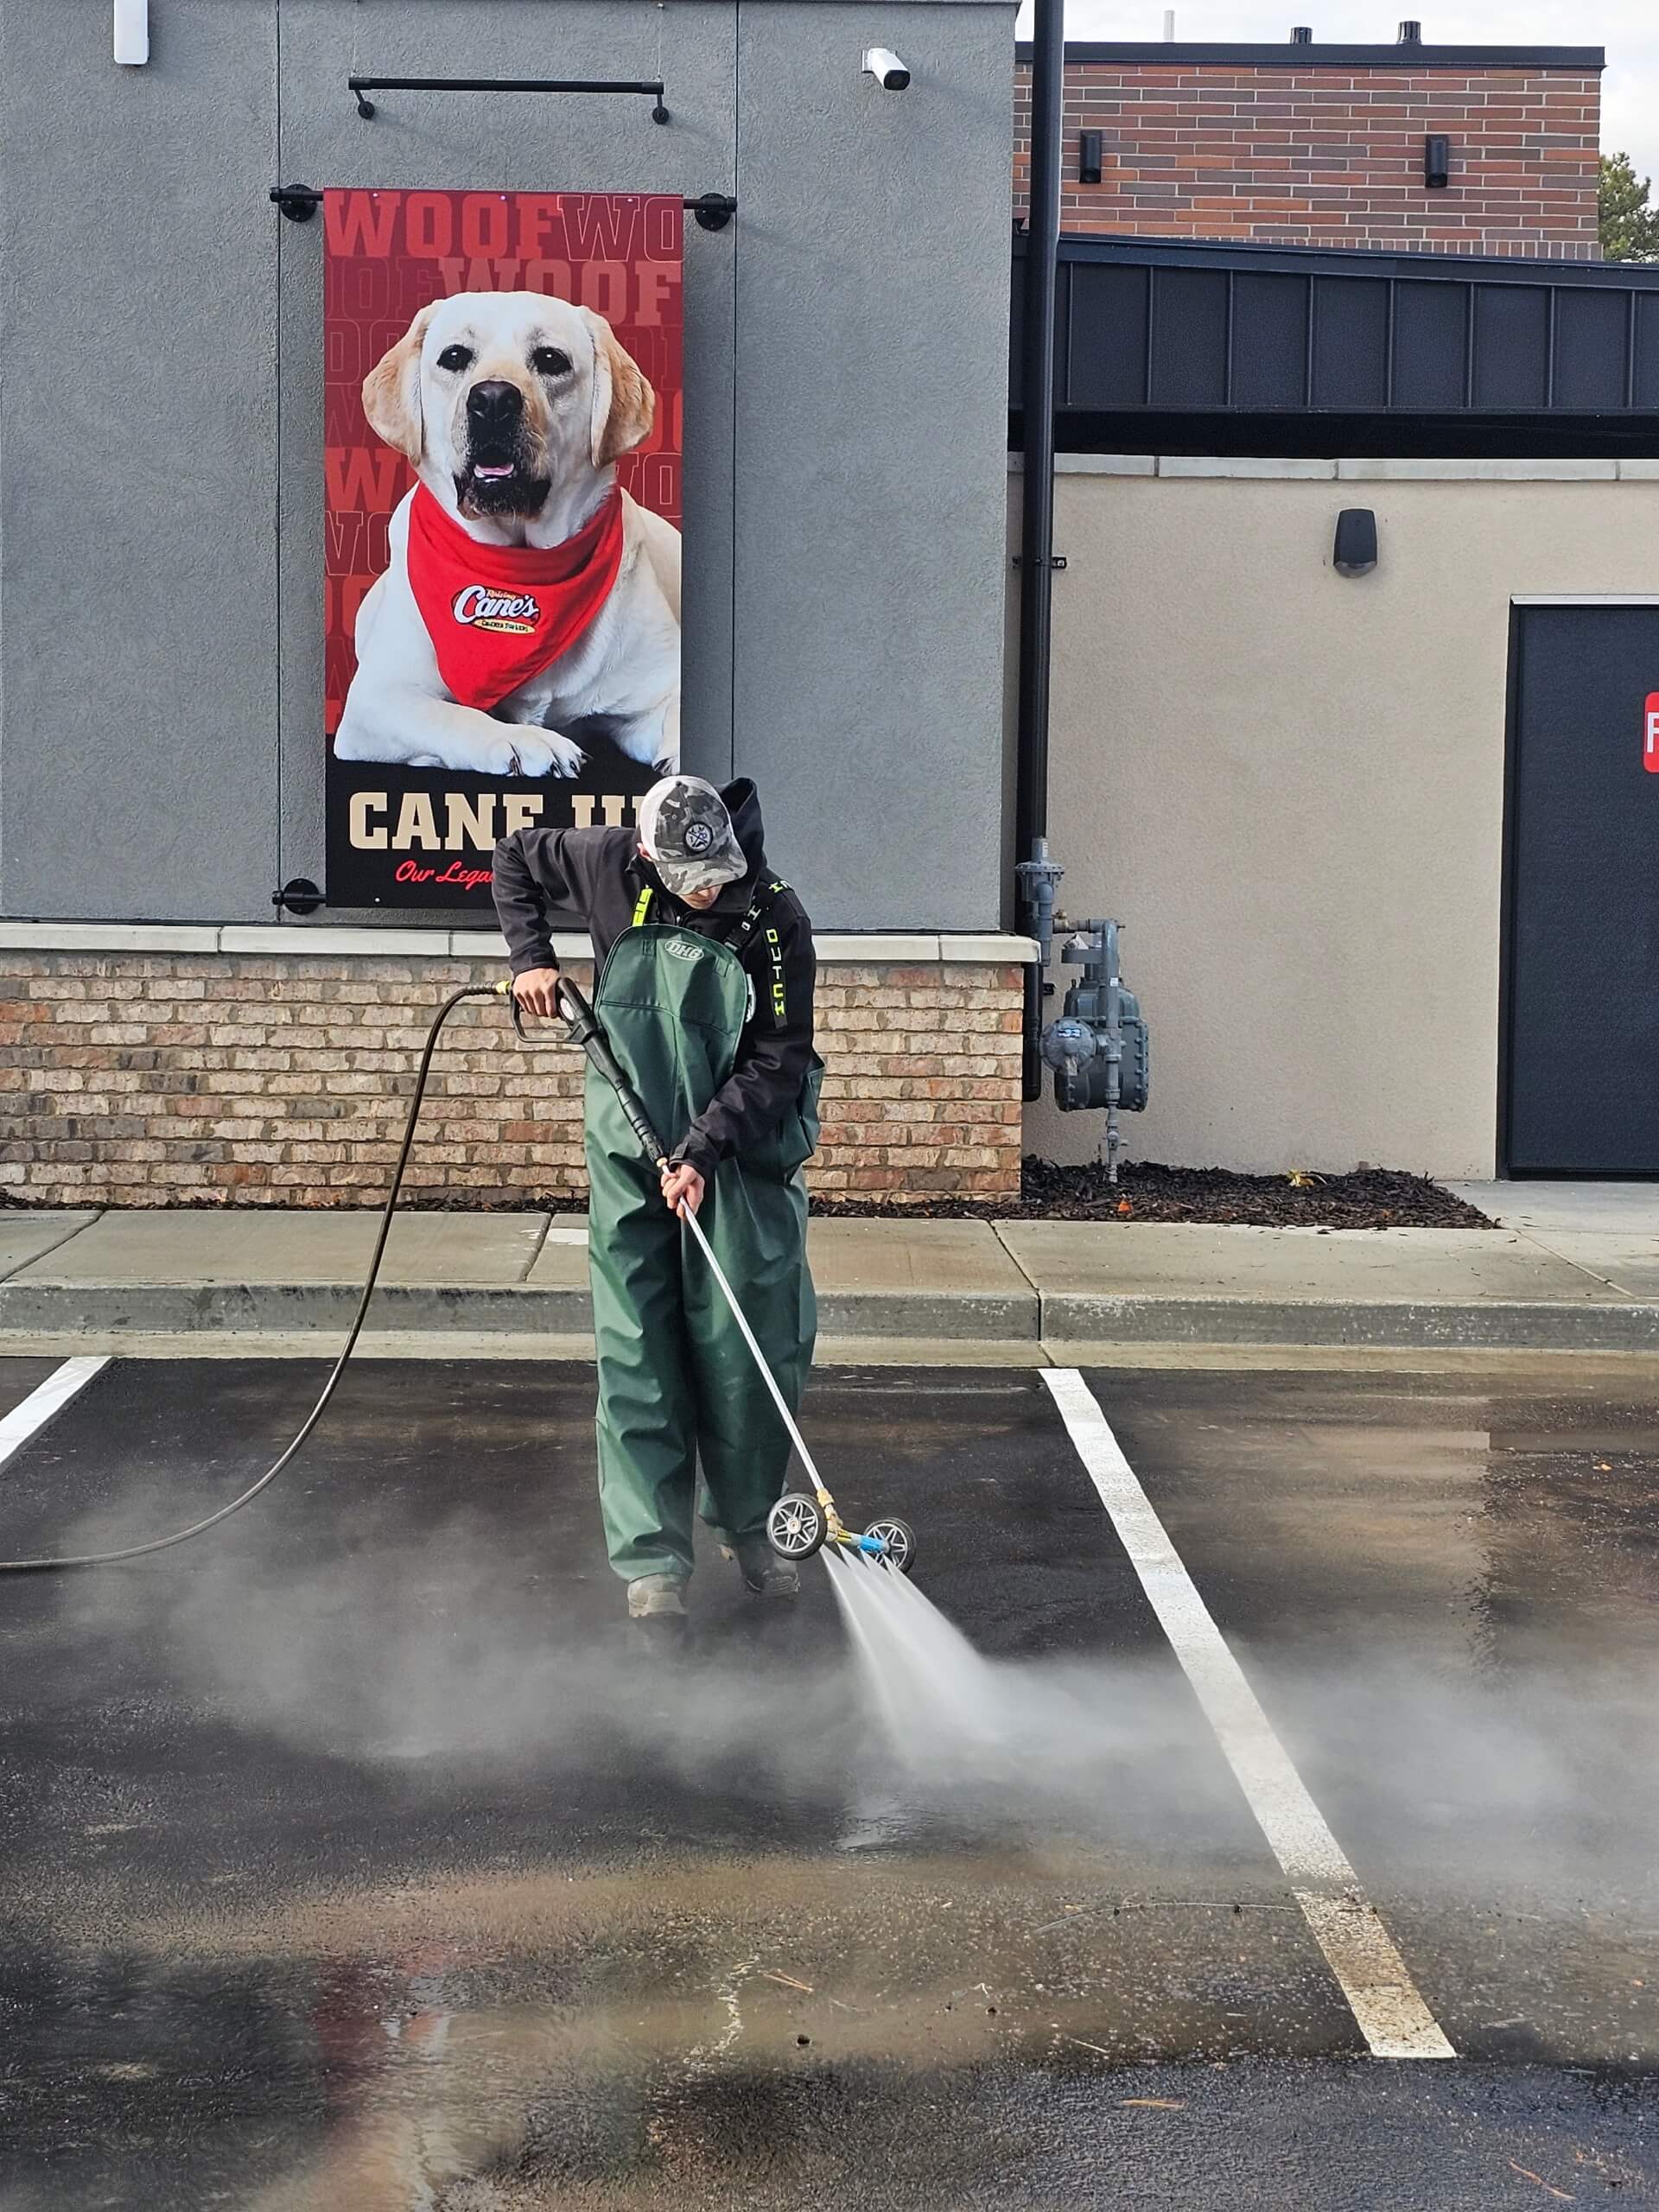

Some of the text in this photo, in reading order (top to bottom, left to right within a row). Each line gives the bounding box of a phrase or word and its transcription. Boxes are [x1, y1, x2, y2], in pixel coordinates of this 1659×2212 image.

[324, 191, 562, 258] WOOF
[454, 585, 539, 624] Cane's
[349, 791, 543, 850] CANE
[395, 860, 435, 883] Our
[766, 928, 785, 1016] DUTCH
